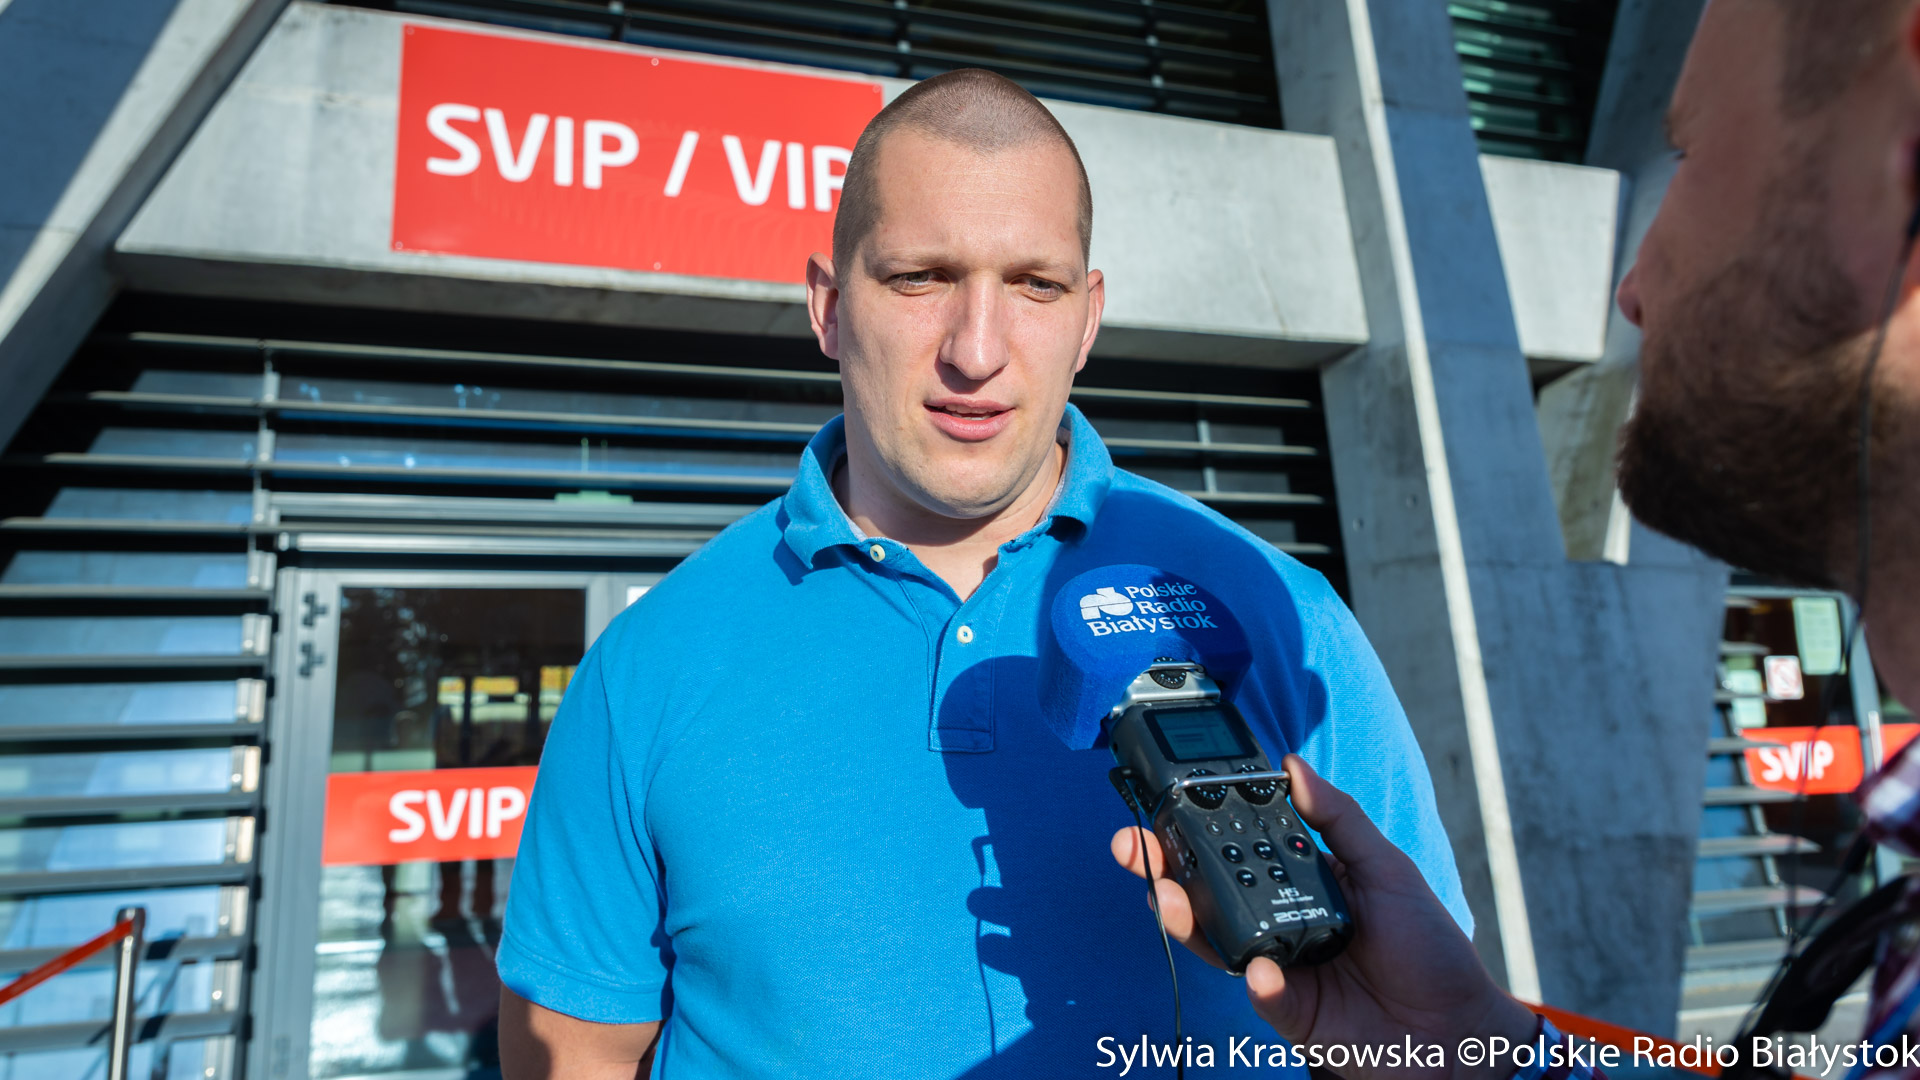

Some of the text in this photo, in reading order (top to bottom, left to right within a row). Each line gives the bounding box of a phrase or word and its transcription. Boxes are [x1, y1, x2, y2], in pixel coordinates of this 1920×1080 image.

[426, 102, 639, 190] SVIP
[663, 131, 699, 197] /
[1124, 582, 1197, 599] Polskie
[1135, 597, 1207, 614] Radio
[1087, 612, 1218, 637] Białystok
[389, 786, 526, 843] SVIP
[1278, 887, 1300, 898] H5
[1273, 907, 1329, 923] ZOOM
